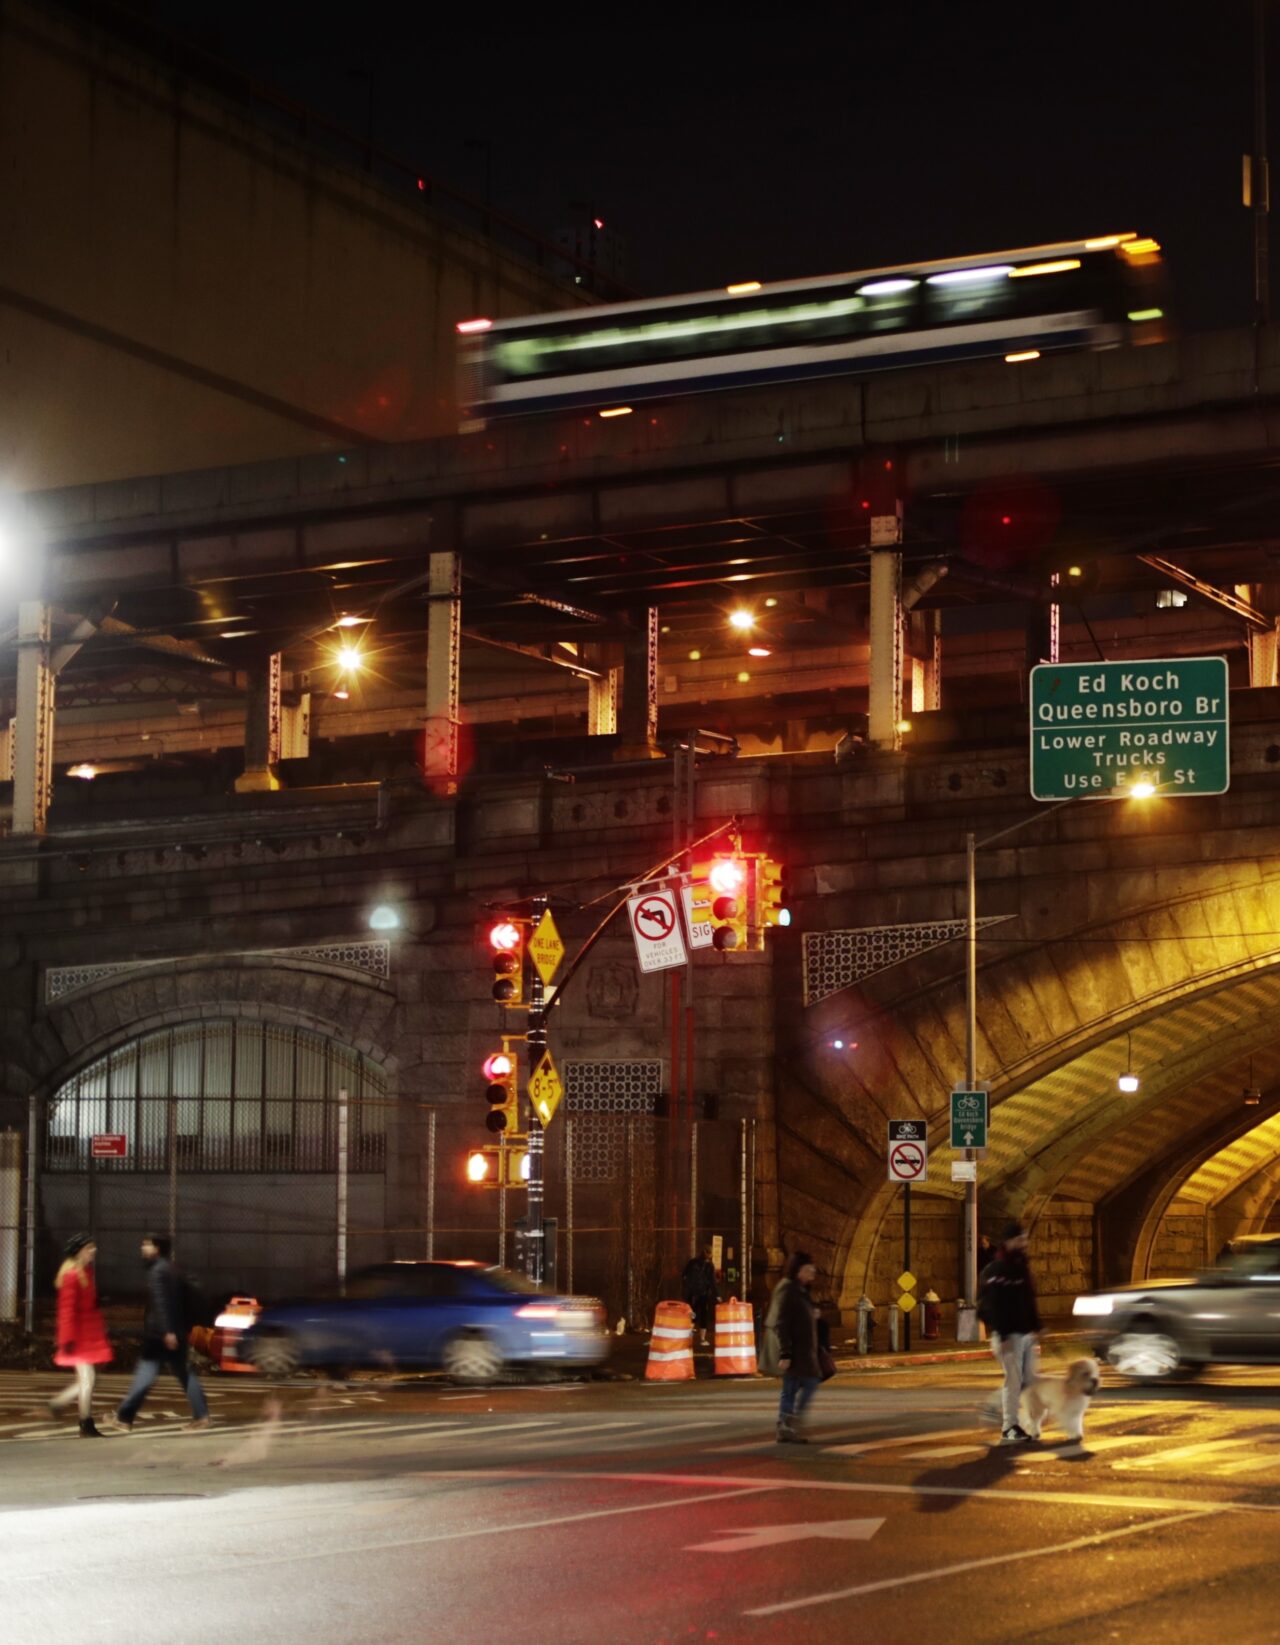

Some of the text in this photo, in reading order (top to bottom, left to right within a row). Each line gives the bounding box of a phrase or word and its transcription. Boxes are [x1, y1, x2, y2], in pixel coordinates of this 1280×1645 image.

[1078, 671, 1180, 693] Ed Koch
[1038, 696, 1220, 722] Queensboro Br
[1040, 729, 1218, 750] Lower Roadway
[1092, 750, 1166, 767] Trucks
[1064, 774, 1102, 788] Use
[1116, 772, 1126, 786] E
[1174, 768, 1196, 785] St
[692, 924, 716, 938] SIG
[533, 937, 560, 950] ONE LANE
[537, 953, 556, 966] BRIDGE
